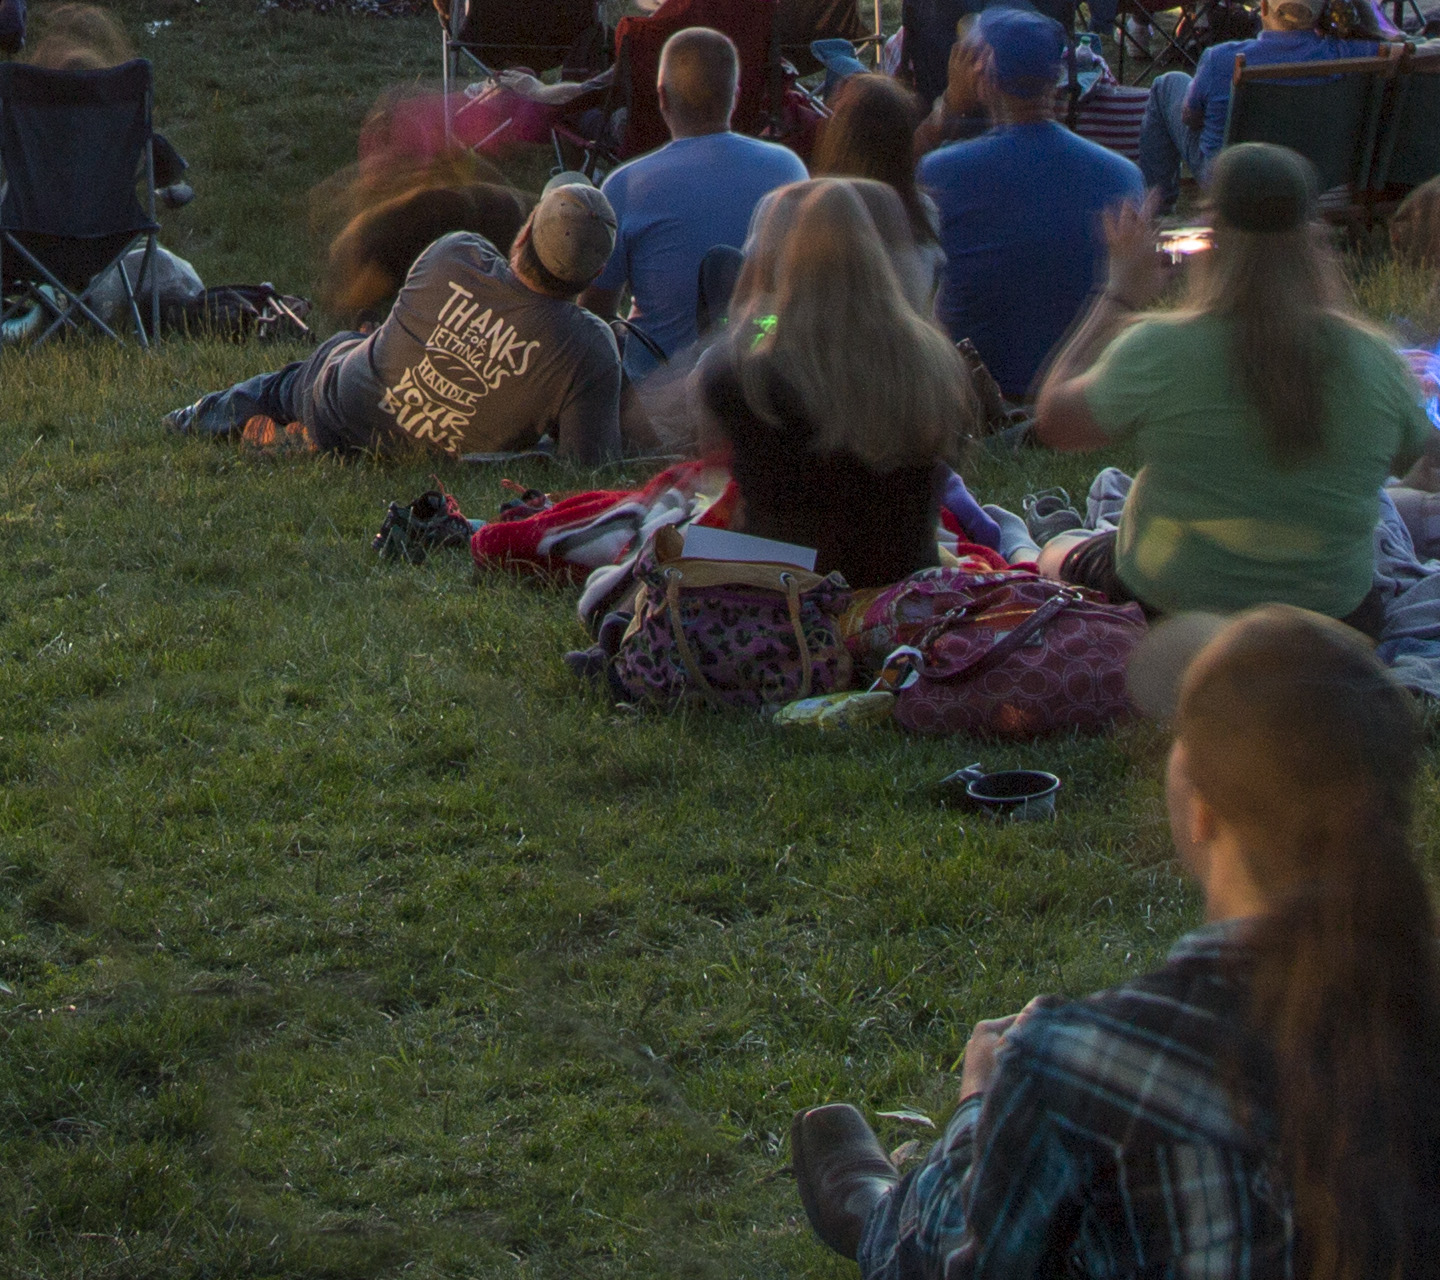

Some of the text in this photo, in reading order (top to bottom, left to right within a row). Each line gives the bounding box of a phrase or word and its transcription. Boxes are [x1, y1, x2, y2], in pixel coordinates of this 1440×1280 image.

[425, 324, 511, 389] LETTING US
[438, 281, 540, 375] THANKS
[461, 327, 488, 352] FOR
[393, 367, 470, 438] YOUR
[418, 354, 478, 404] HANDLE
[378, 387, 465, 452] BUNS
